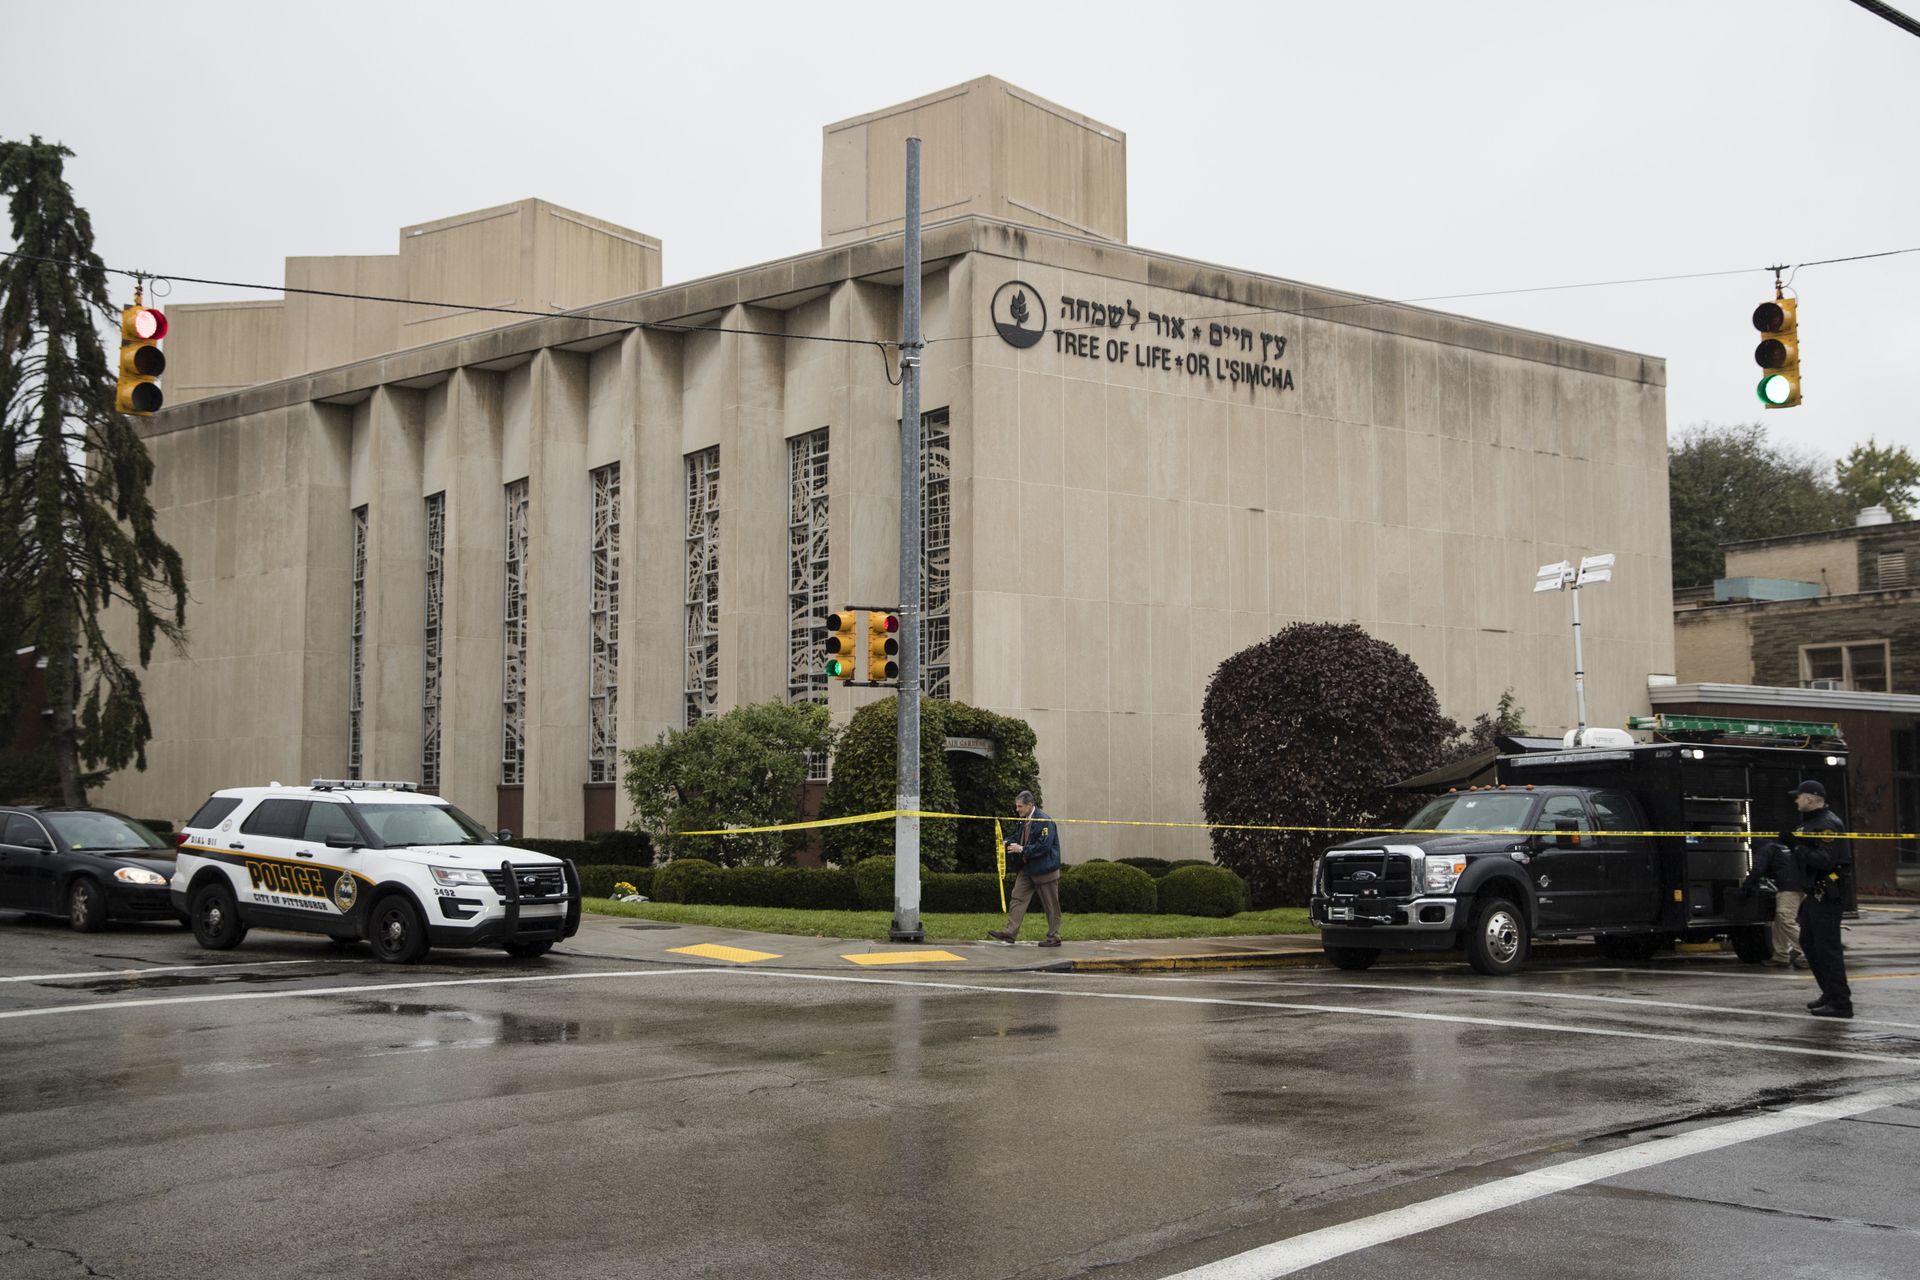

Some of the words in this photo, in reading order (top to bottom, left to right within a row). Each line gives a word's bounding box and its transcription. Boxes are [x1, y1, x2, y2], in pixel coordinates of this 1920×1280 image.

[1061, 295, 1141, 331] לשמחה
[1148, 311, 1185, 339] אור
[1209, 322, 1253, 352] חיים
[1260, 331, 1288, 362] עץ
[1053, 329, 1100, 359] TREE
[1106, 339, 1129, 363] OF
[1136, 343, 1172, 371] LIFE
[1186, 352, 1210, 377] OR
[1217, 357, 1295, 391] L'SIMCHA
[245, 861, 328, 898] POLICE
[434, 887, 456, 897] 3492
[253, 893, 270, 902] CITY
[271, 896, 281, 904] OF
[282, 897, 329, 911] PITTSBURGH
